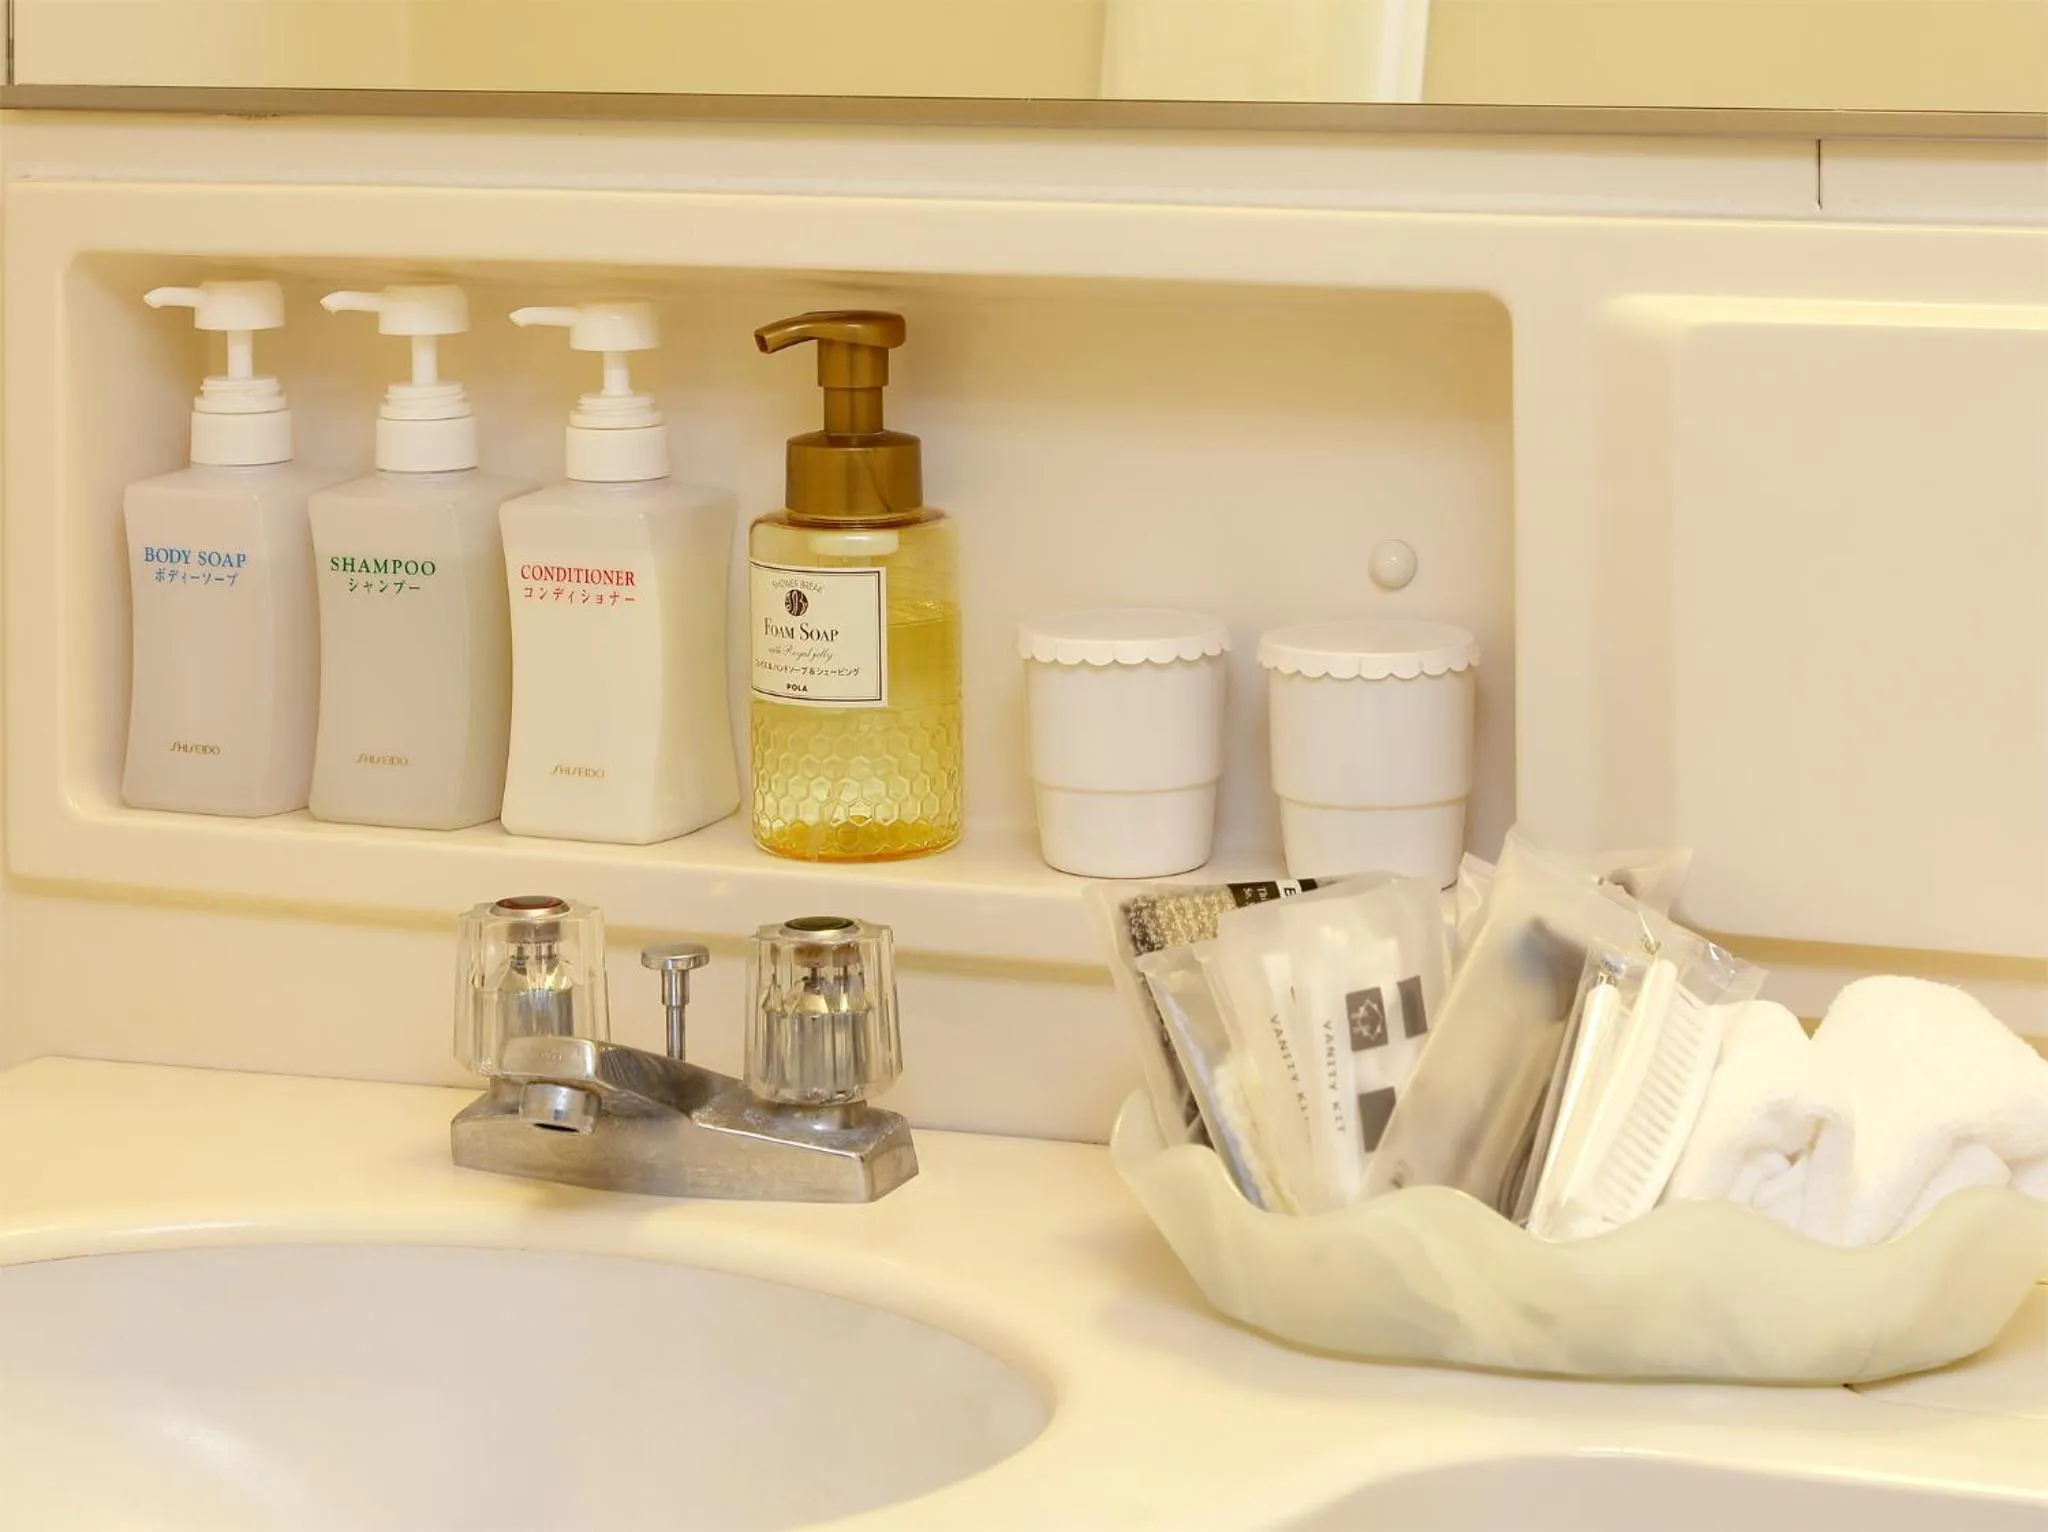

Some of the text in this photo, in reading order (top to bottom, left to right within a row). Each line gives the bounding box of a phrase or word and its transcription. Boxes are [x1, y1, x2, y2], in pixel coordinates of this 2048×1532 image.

[144, 546, 246, 567] BODY SOAP
[330, 556, 436, 576] SHAMPOO
[155, 568, 237, 586] ボディーソープ
[521, 564, 635, 586] CONDITIONER
[349, 578, 420, 594] シャンプー
[524, 587, 635, 606] コンディショナー
[786, 683, 808, 692] POLA
[1270, 1014, 1300, 1082] VANITY
[1322, 1019, 1346, 1133] VANITY KIT
